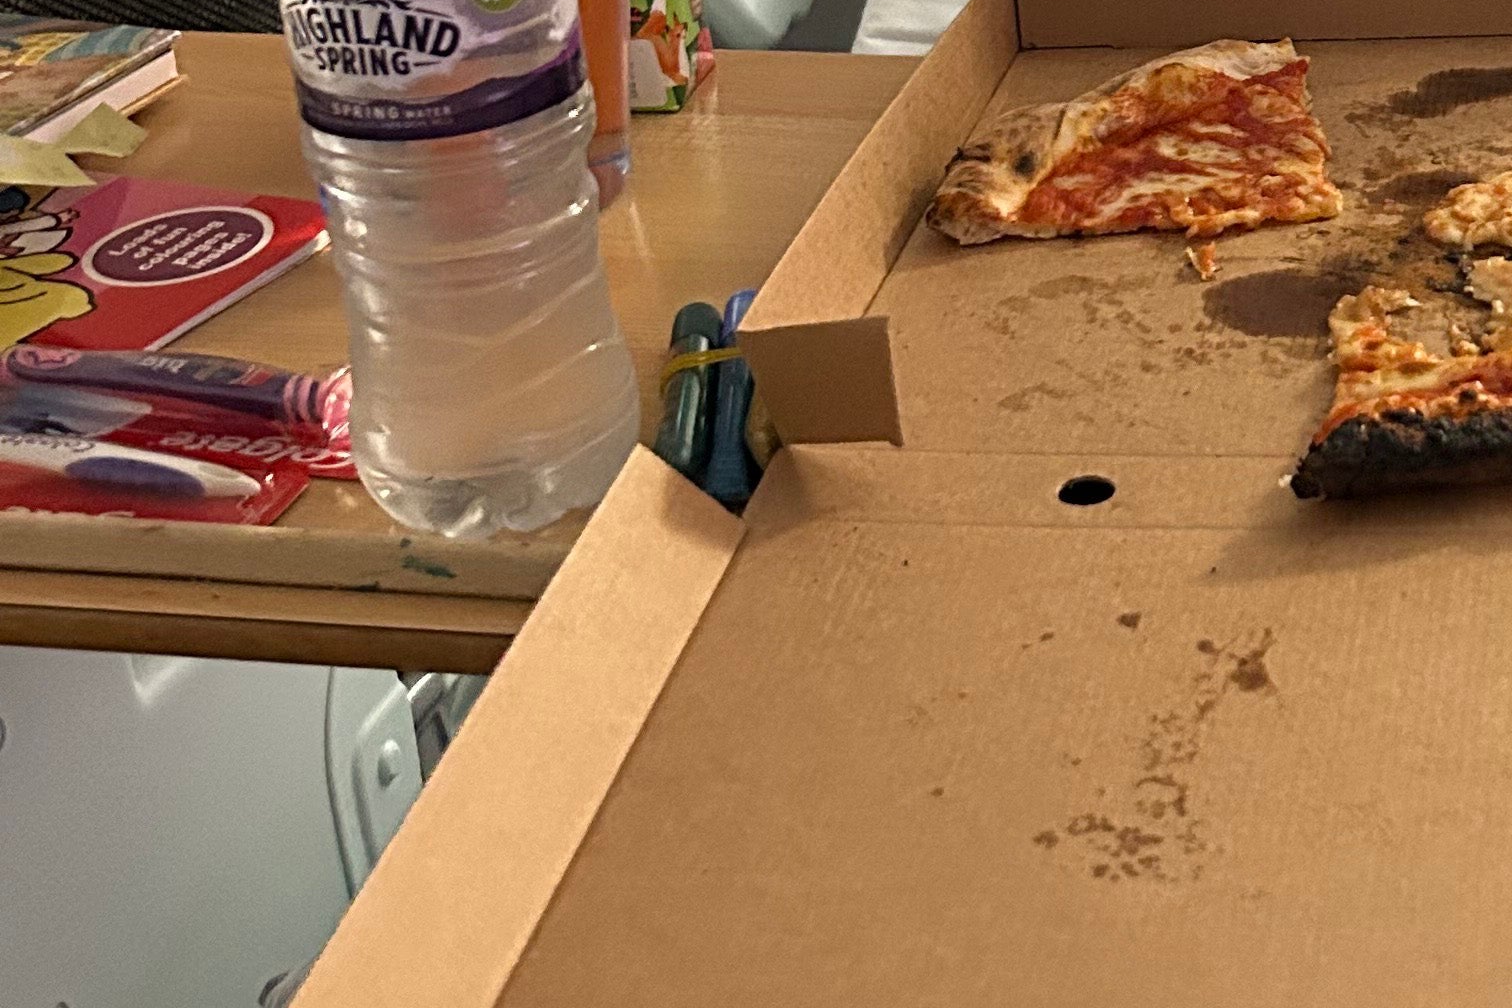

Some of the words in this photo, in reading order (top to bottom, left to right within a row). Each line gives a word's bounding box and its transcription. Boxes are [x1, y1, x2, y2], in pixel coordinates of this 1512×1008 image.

[314, 46, 411, 76] SPRING
[330, 101, 400, 120] SPRING
[107, 223, 168, 256] Loads
[133, 246, 154, 259] of
[151, 227, 189, 245] fun
[138, 220, 226, 271] colouring
[171, 232, 229, 266] pages
